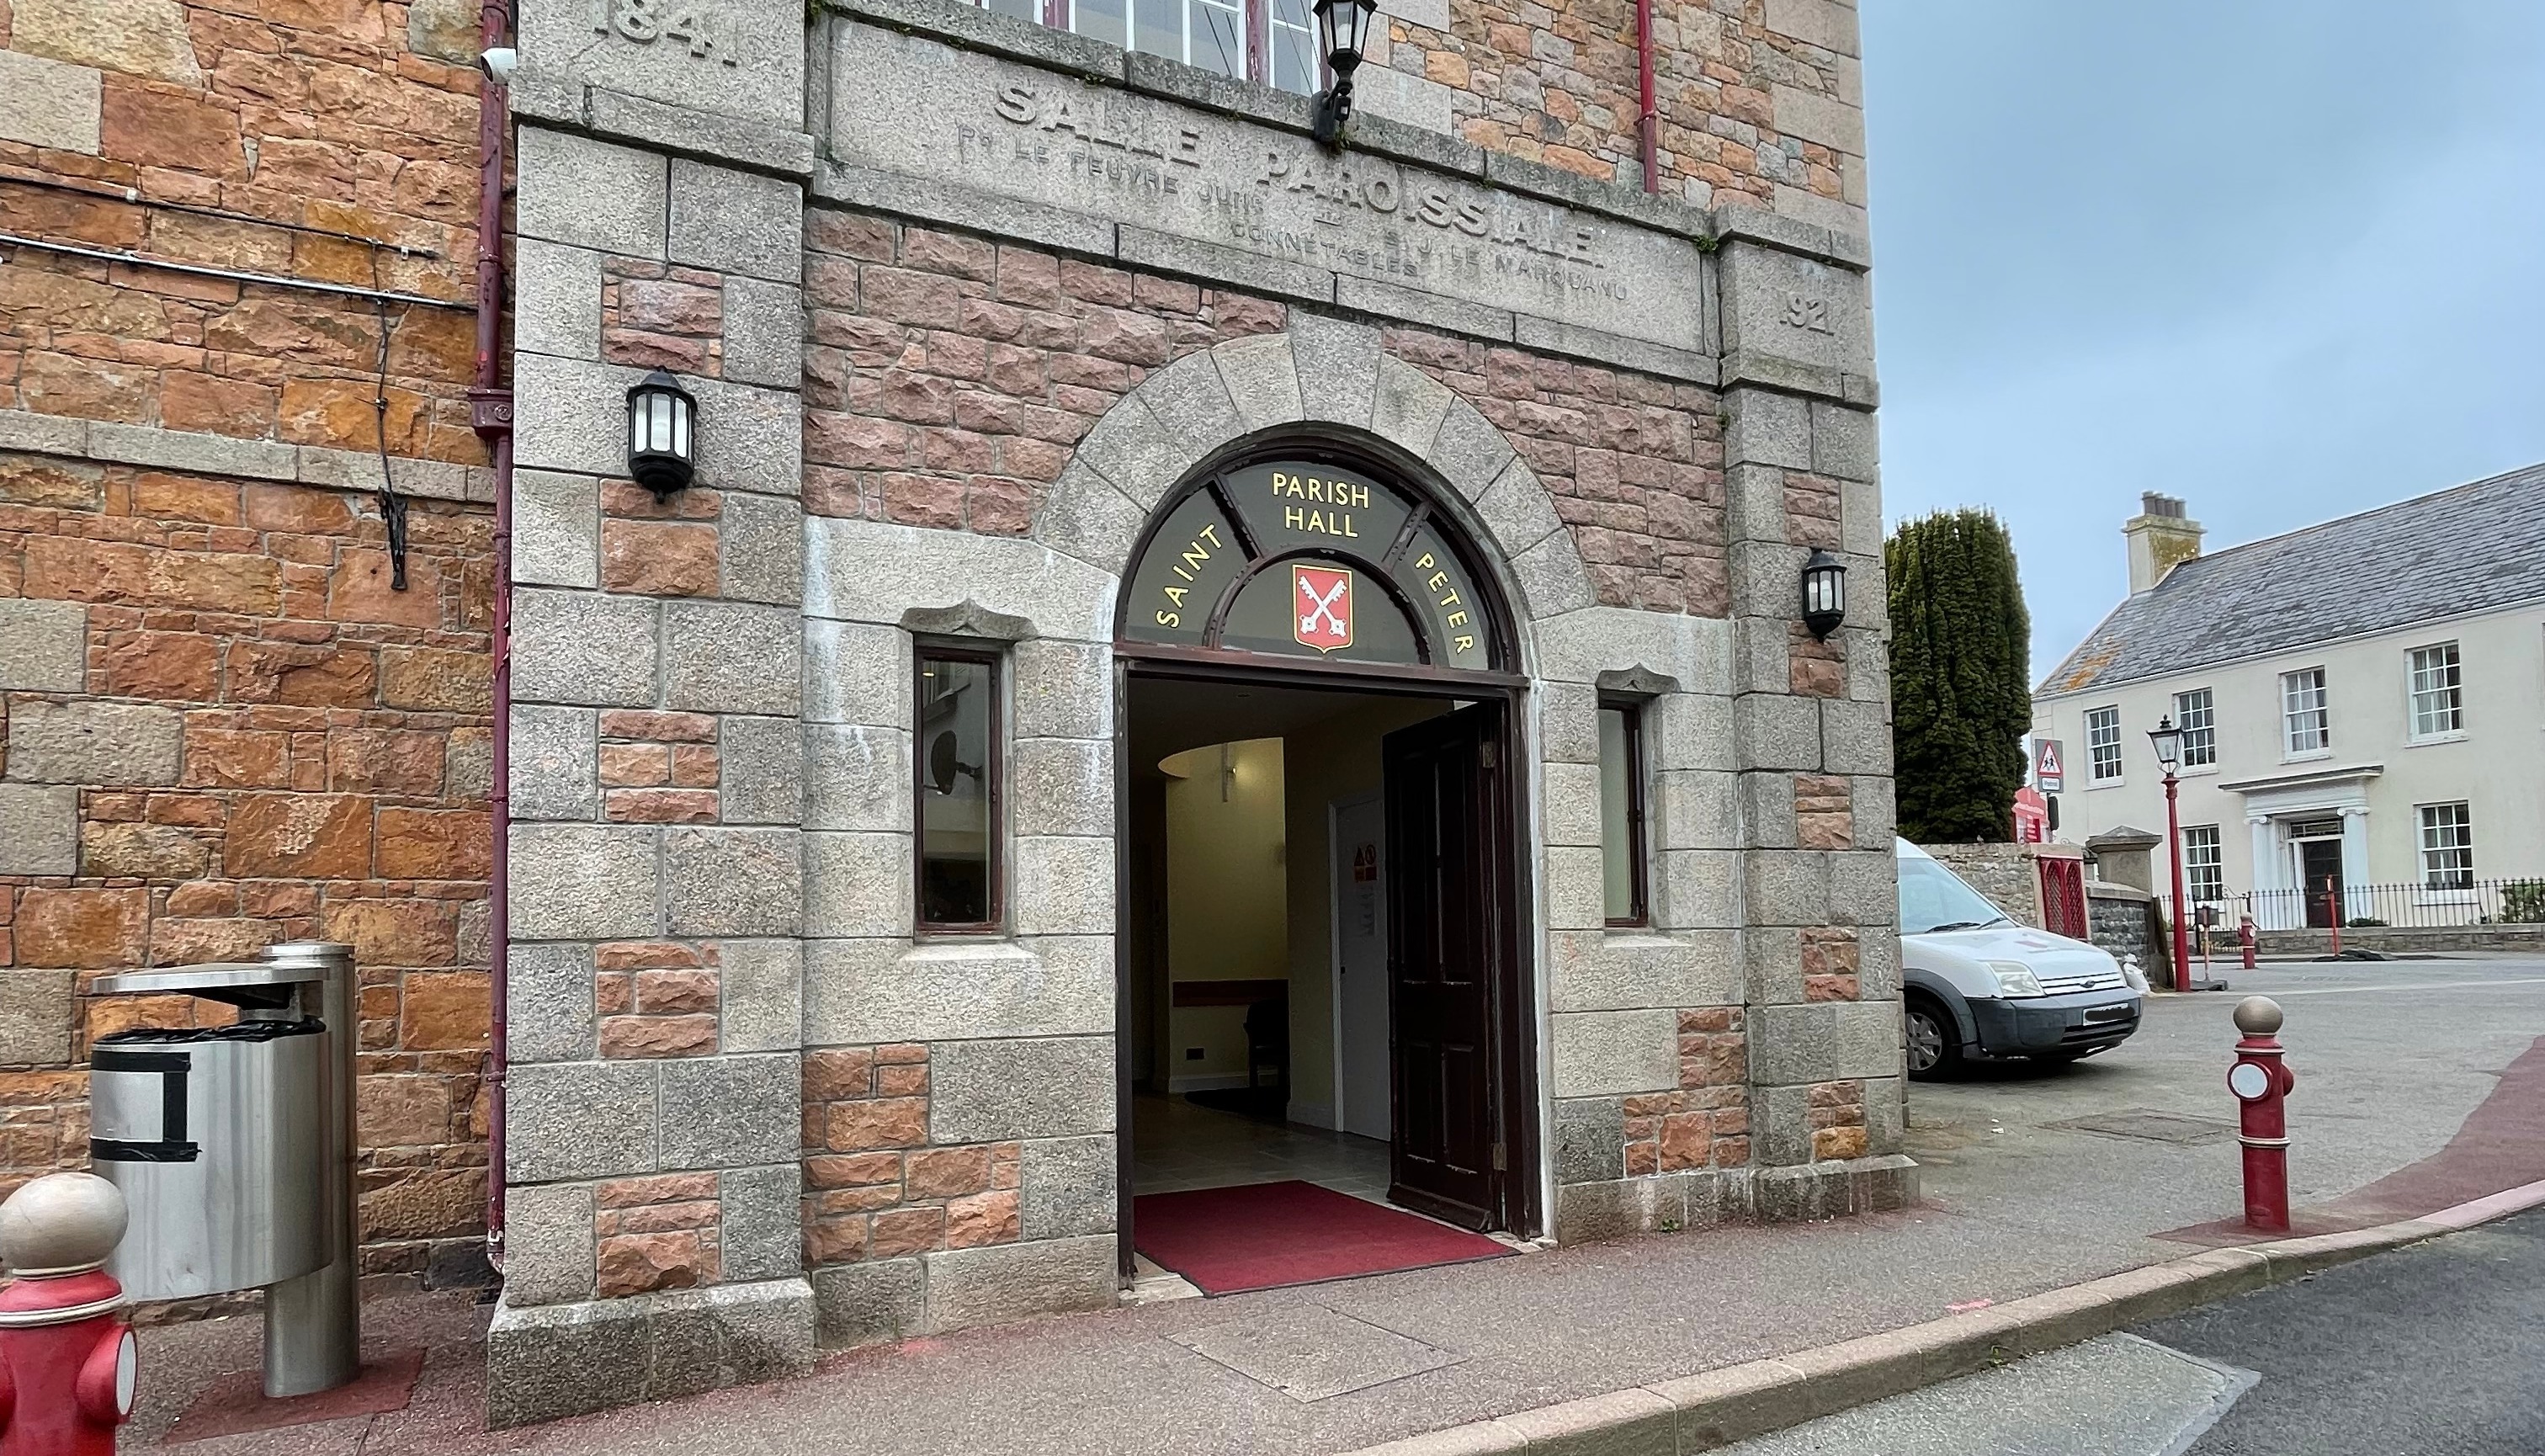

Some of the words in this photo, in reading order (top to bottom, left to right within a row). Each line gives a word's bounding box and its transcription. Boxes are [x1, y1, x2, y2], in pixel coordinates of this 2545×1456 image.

[992, 82, 1202, 169] SALLE
[1014, 136, 1050, 165] LE
[1272, 472, 1370, 509] PARISH
[1284, 505, 1359, 539] HALL
[1156, 523, 1225, 630] SAINT
[1414, 551, 1474, 656] PETER
